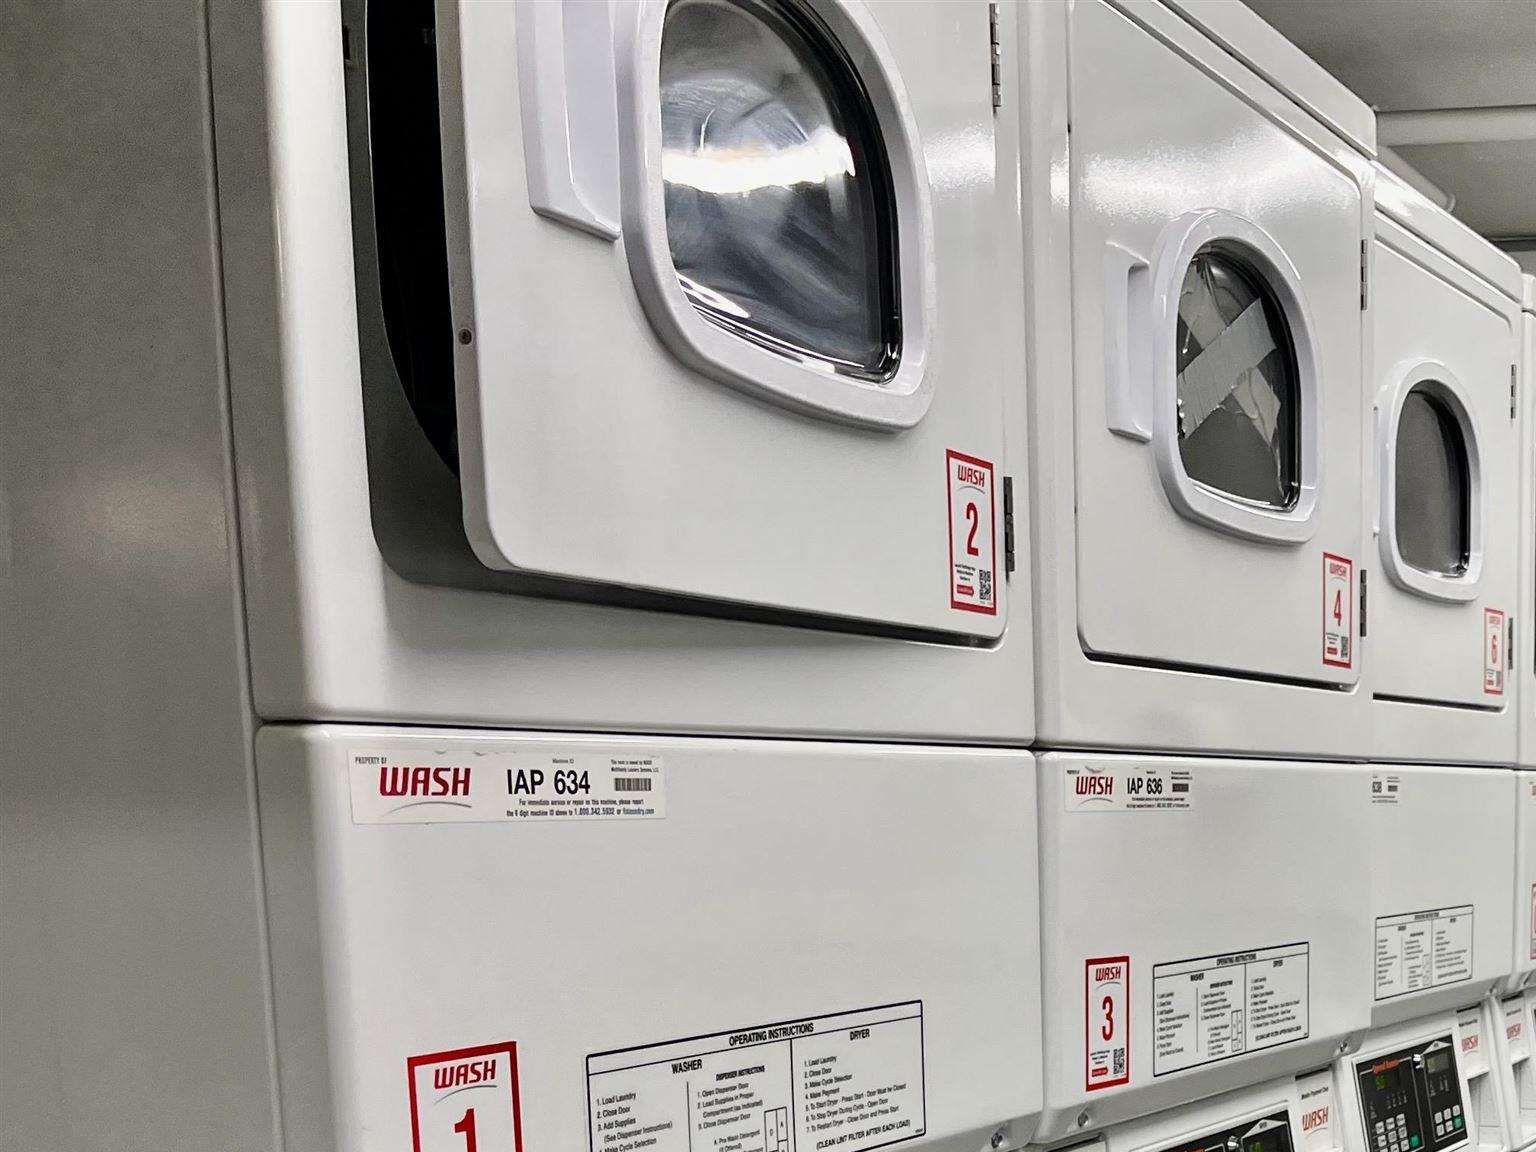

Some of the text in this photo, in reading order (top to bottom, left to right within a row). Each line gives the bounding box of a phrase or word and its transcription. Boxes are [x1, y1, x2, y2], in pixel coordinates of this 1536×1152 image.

[958, 465, 985, 487] WASH
[966, 502, 978, 556] 2
[1334, 590, 1342, 626] 4
[380, 767, 471, 796] WASH
[507, 770, 591, 795] IAP 634
[1076, 776, 1114, 795] WASH
[1127, 778, 1163, 794] IAP 636
[1096, 966, 1121, 982] WASH
[1102, 996, 1113, 1041] 3
[729, 1023, 814, 1047] OPERATING INSTRUCTIONS
[850, 1029, 870, 1041] DRYER
[434, 1060, 496, 1089] WASH
[672, 1059, 702, 1074] WASHER
[602, 1096, 615, 1105] Load
[1302, 1106, 1328, 1131] WASH
